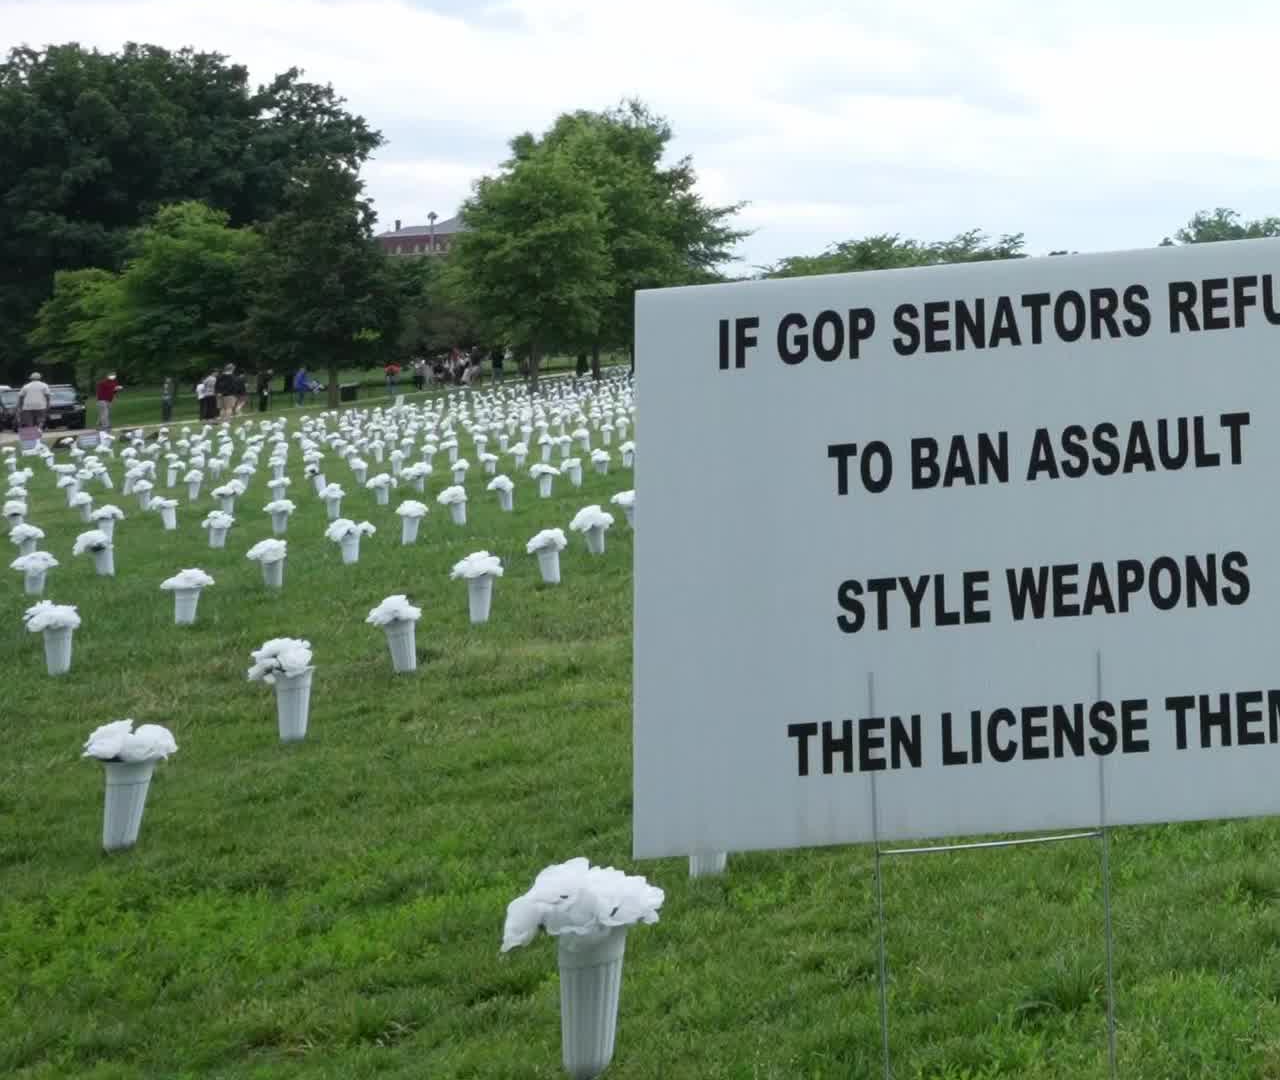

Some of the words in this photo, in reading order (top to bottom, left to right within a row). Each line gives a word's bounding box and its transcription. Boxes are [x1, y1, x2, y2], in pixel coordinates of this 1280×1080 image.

[719, 317, 760, 370] IF
[777, 308, 876, 366] GOP
[892, 285, 1152, 357] SENATORS
[828, 441, 893, 497] TO
[910, 431, 1010, 490] BAN
[1027, 412, 1251, 482] ASSAULT
[836, 571, 992, 635] STYLE
[1006, 551, 1251, 622] WEAPONS
[787, 714, 923, 777] THEN
[941, 699, 1150, 767] LICENSE
